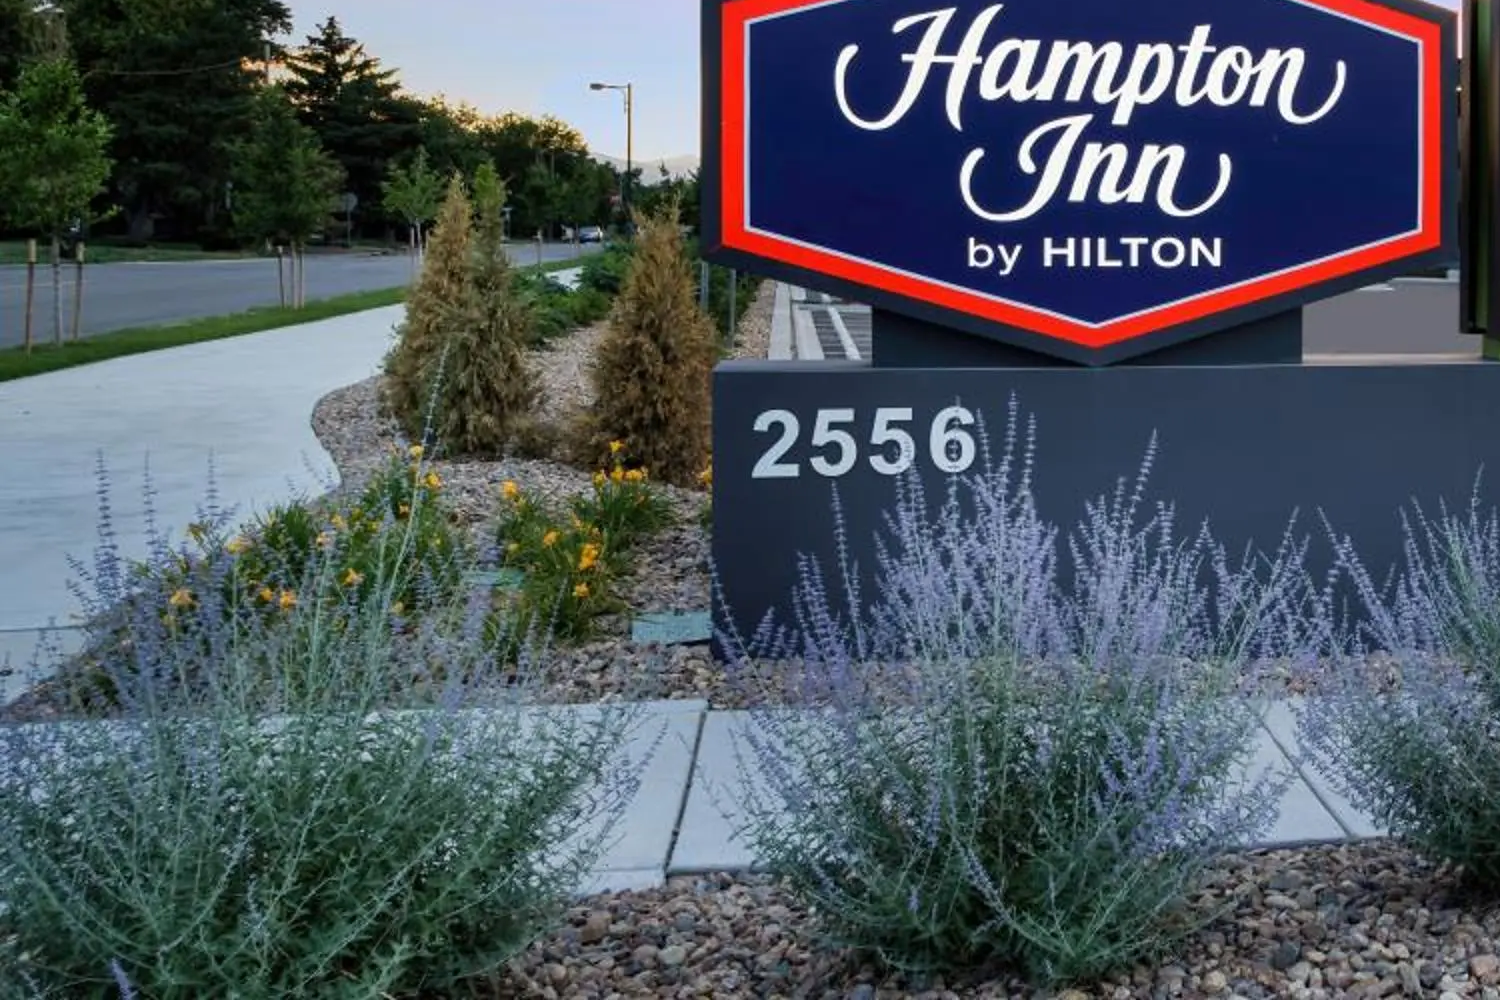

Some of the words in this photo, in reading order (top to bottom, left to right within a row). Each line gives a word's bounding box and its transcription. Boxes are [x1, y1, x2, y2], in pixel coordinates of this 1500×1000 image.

[834, 3, 1347, 131] Hampton
[959, 113, 1232, 222] Inn
[967, 236, 1023, 276] by
[1043, 236, 1223, 268] HILTON
[751, 405, 976, 478] 2556
